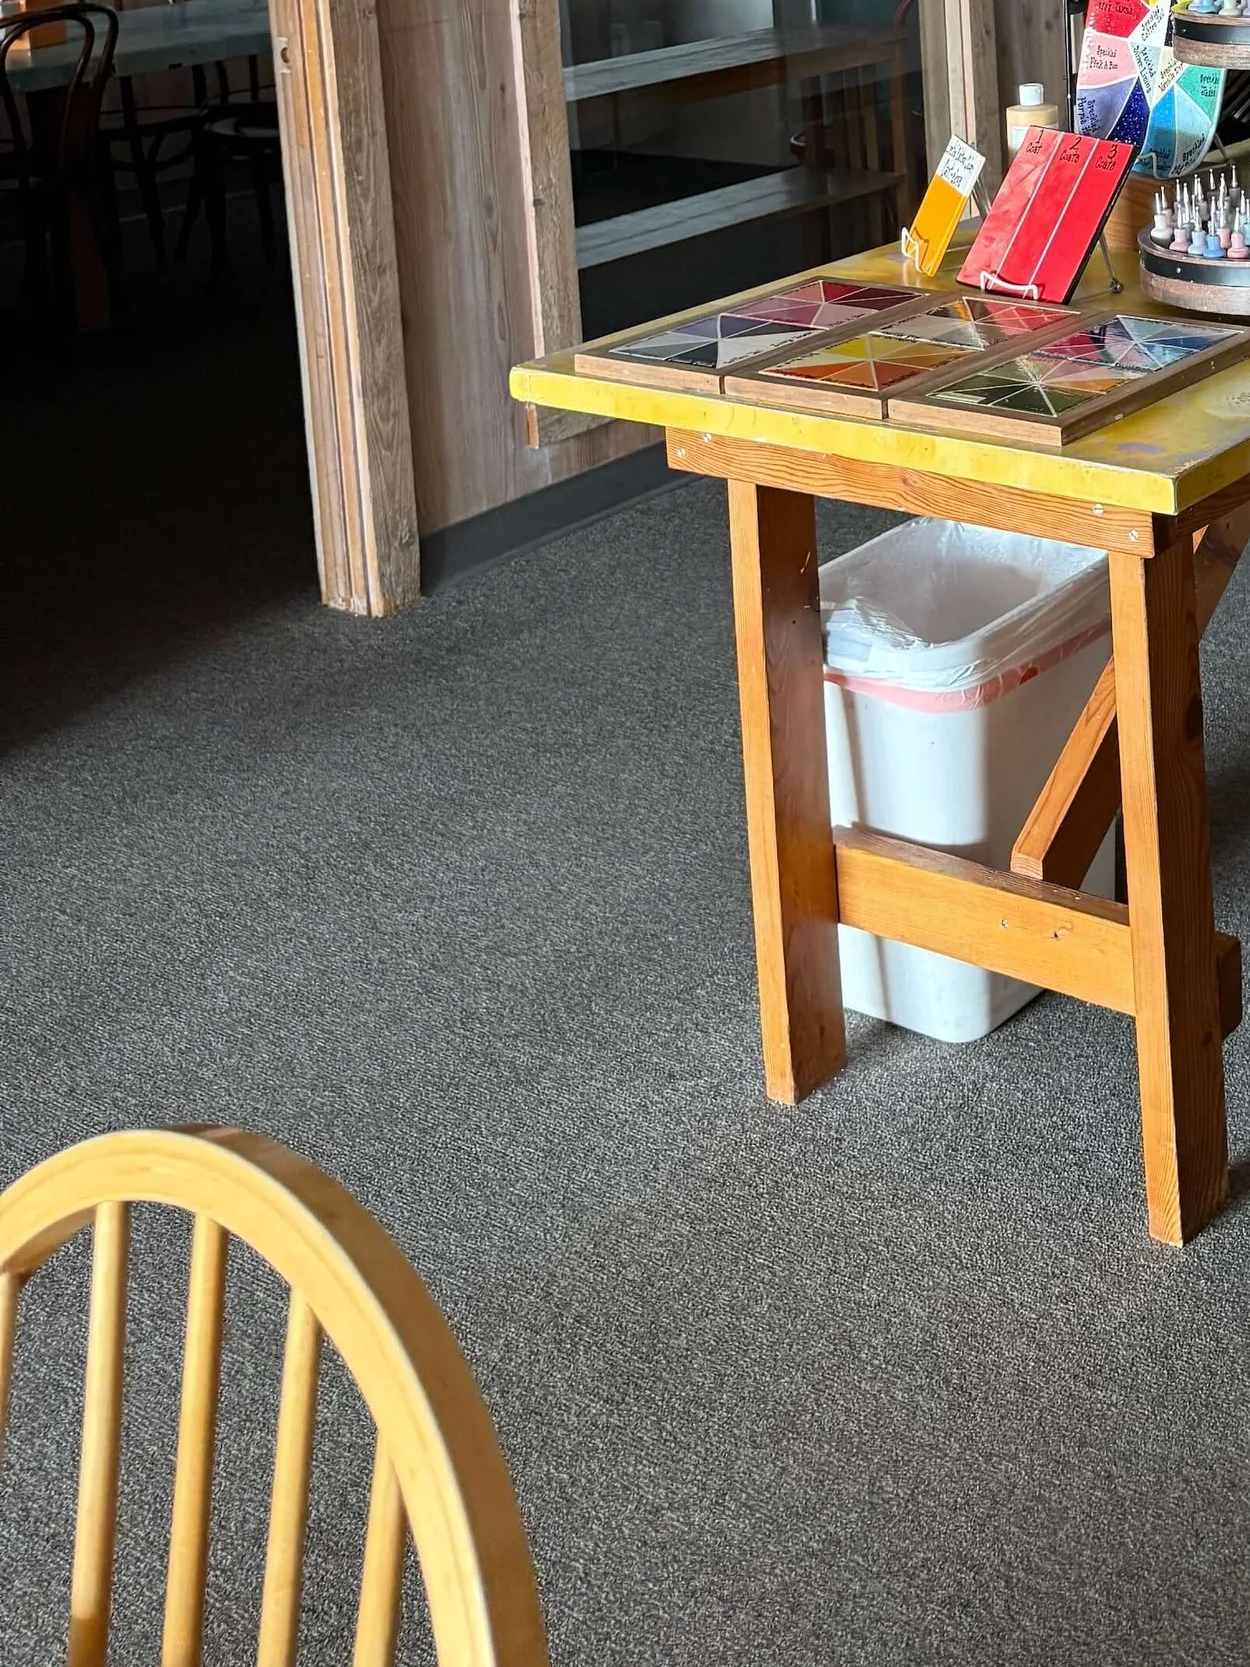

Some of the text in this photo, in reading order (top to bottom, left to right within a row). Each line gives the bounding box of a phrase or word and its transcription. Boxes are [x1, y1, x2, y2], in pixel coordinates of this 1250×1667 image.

[1035, 130, 1044, 144] 1
[1069, 137, 1082, 151] 2
[1026, 142, 1043, 154] Coat
[1107, 144, 1118, 161] 3
[1060, 149, 1080, 163] Coats
[1095, 156, 1117, 171] Coats
